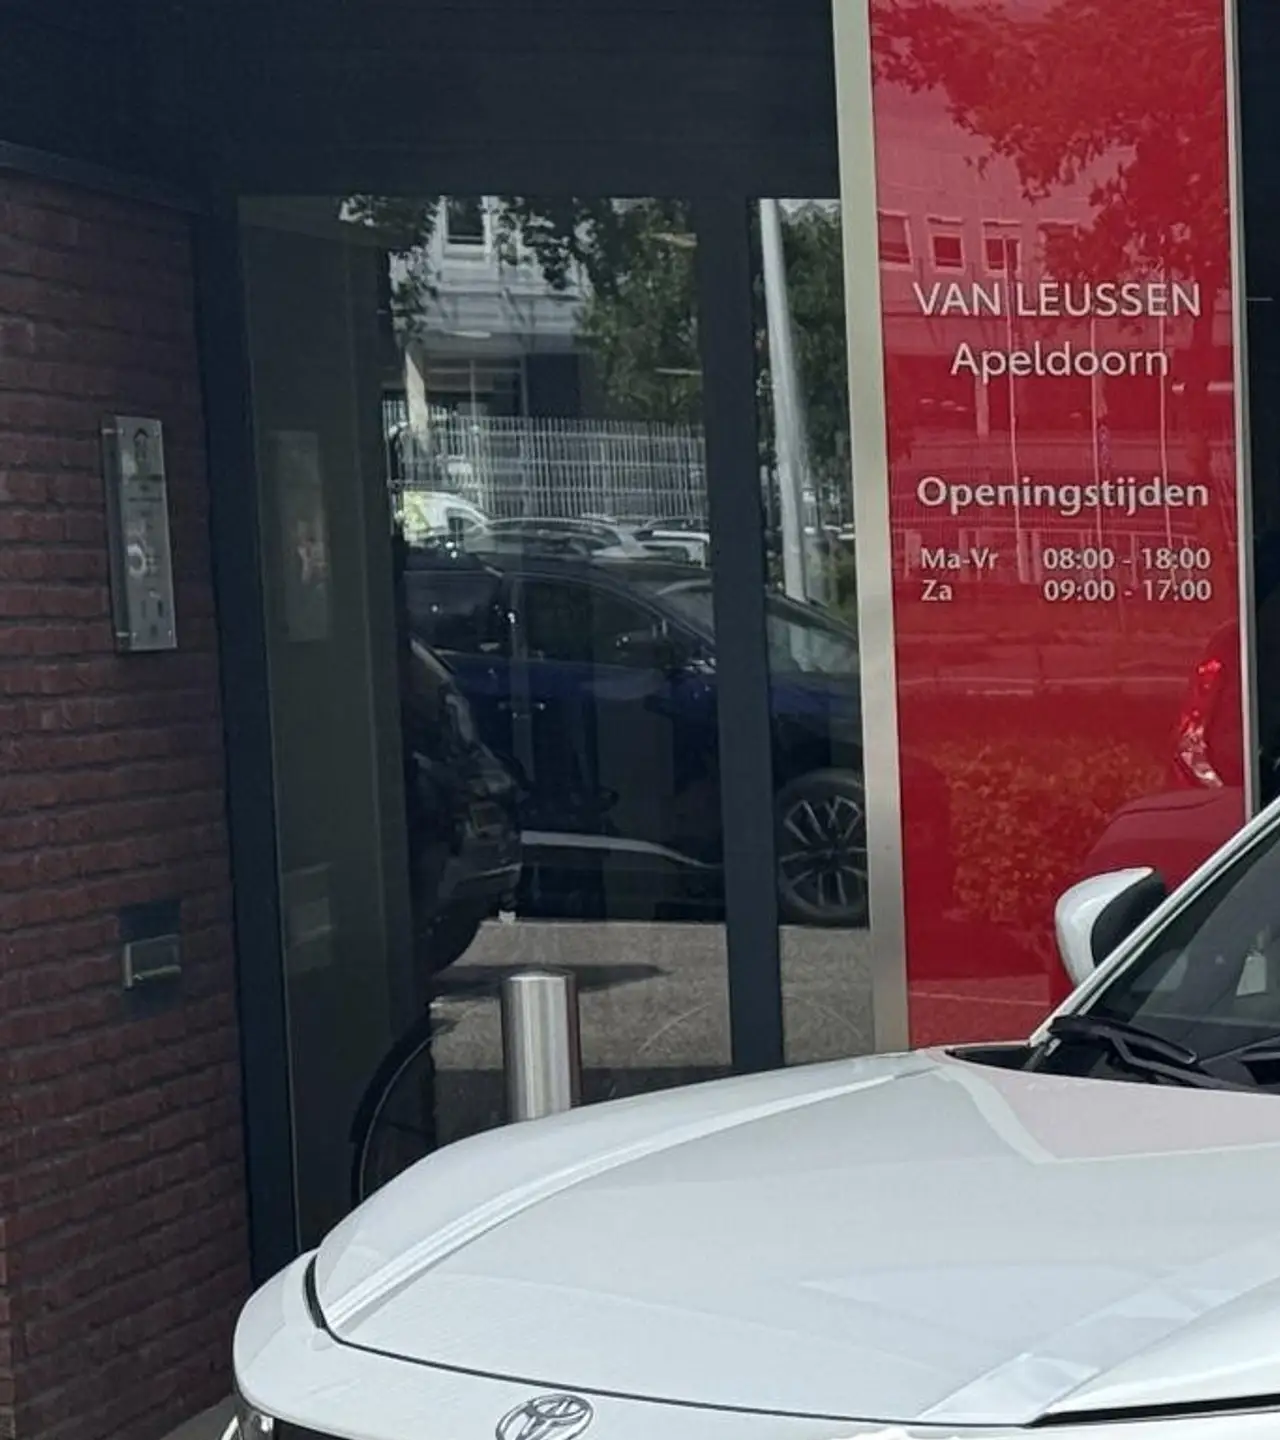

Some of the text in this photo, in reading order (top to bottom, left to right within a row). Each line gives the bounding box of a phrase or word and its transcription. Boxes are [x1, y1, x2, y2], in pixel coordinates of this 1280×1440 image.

[913, 282, 1201, 317] VAN LEUSSEN
[950, 342, 1168, 382] Apeldoorn
[916, 477, 1209, 515] Openingstijden
[921, 549, 998, 570] Ma-Vr
[1043, 549, 1114, 570] 08:00
[1143, 549, 1211, 570] 18:00
[922, 581, 952, 601] Za
[1044, 580, 1115, 601] 09:00
[1144, 580, 1211, 601] 17:00
